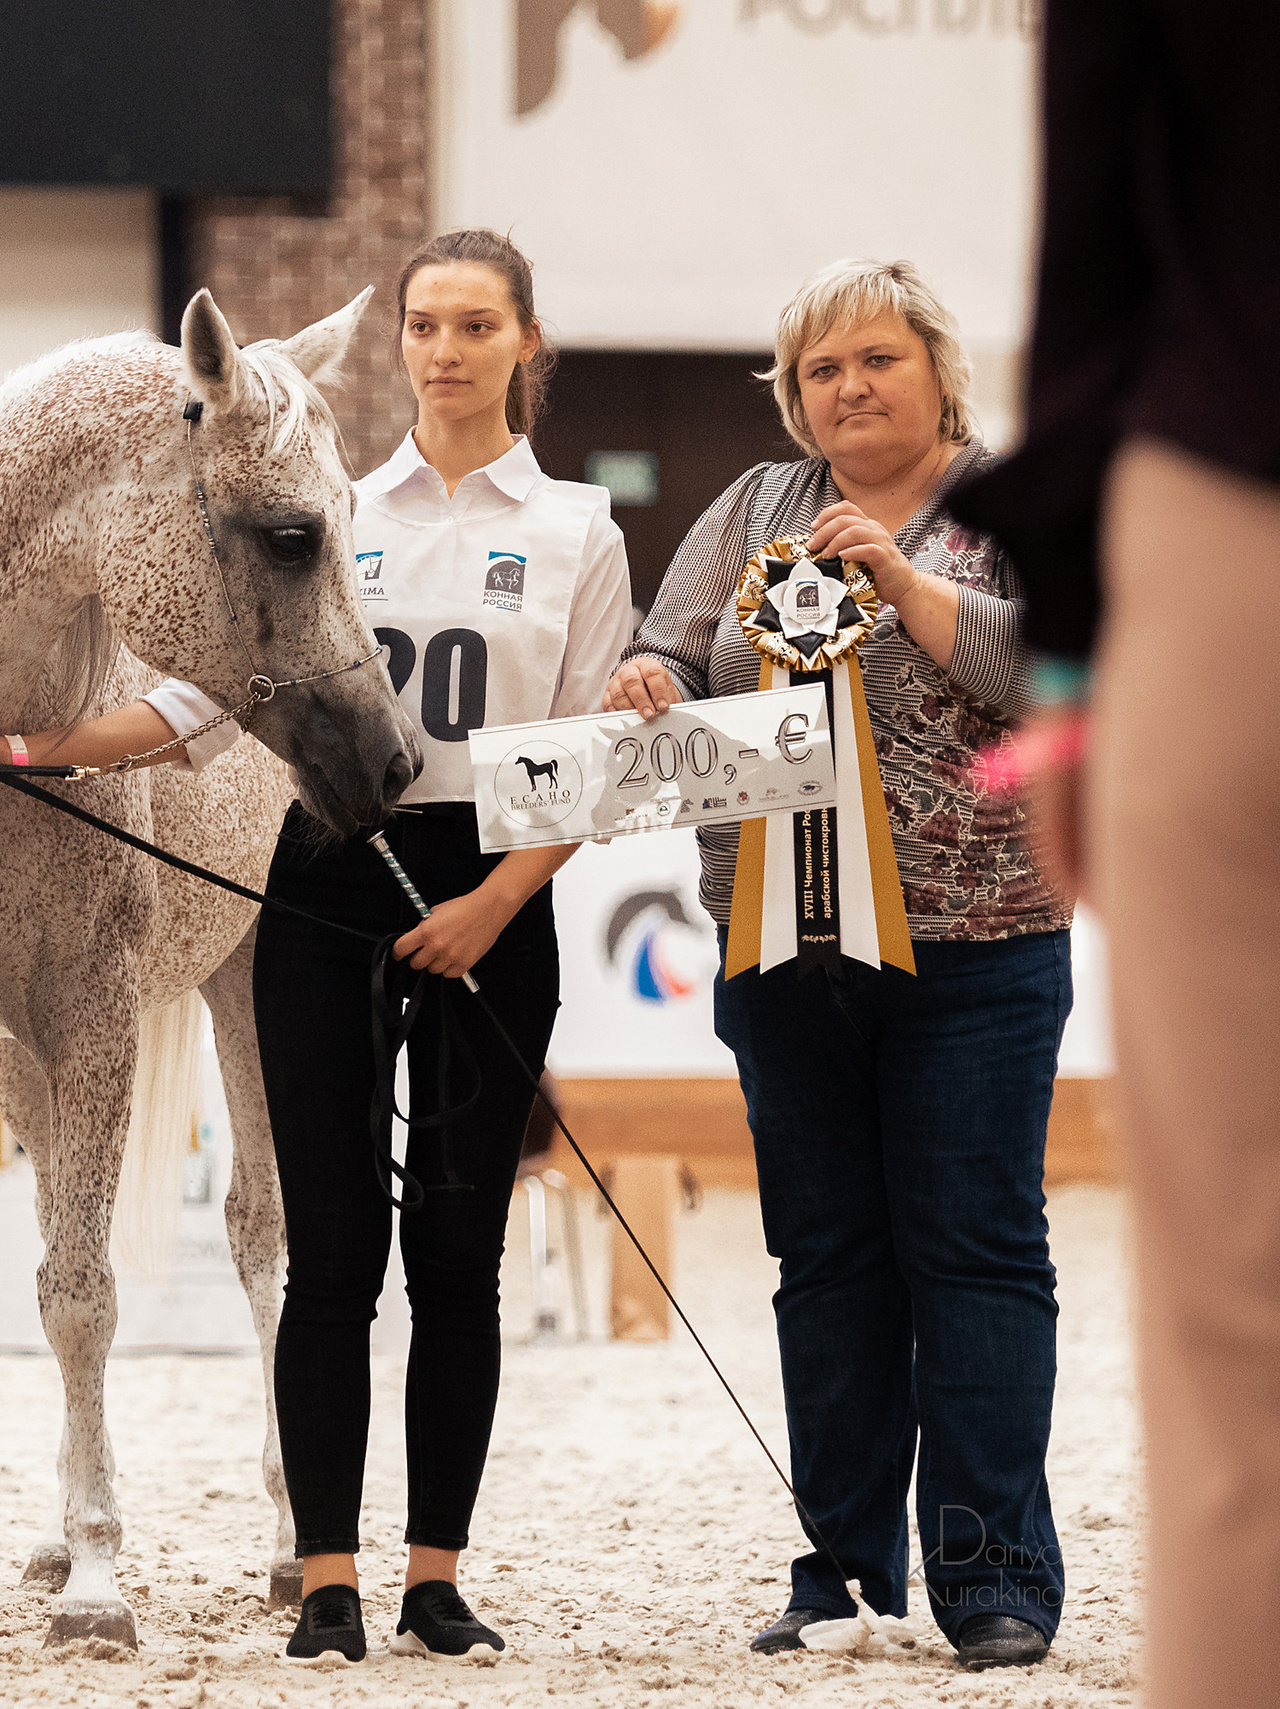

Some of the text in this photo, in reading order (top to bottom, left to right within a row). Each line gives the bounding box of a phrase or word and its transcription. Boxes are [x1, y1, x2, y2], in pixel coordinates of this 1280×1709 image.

[482, 599, 523, 610] РОССИЯ
[483, 591, 523, 602] КОННАЯ
[774, 713, 814, 765] €
[510, 789, 571, 805] ECAHO
[551, 797, 571, 806] FUND
[803, 828, 813, 888] Чемпионат
[803, 890, 815, 919] XVIII
[820, 869, 833, 919] арабской
